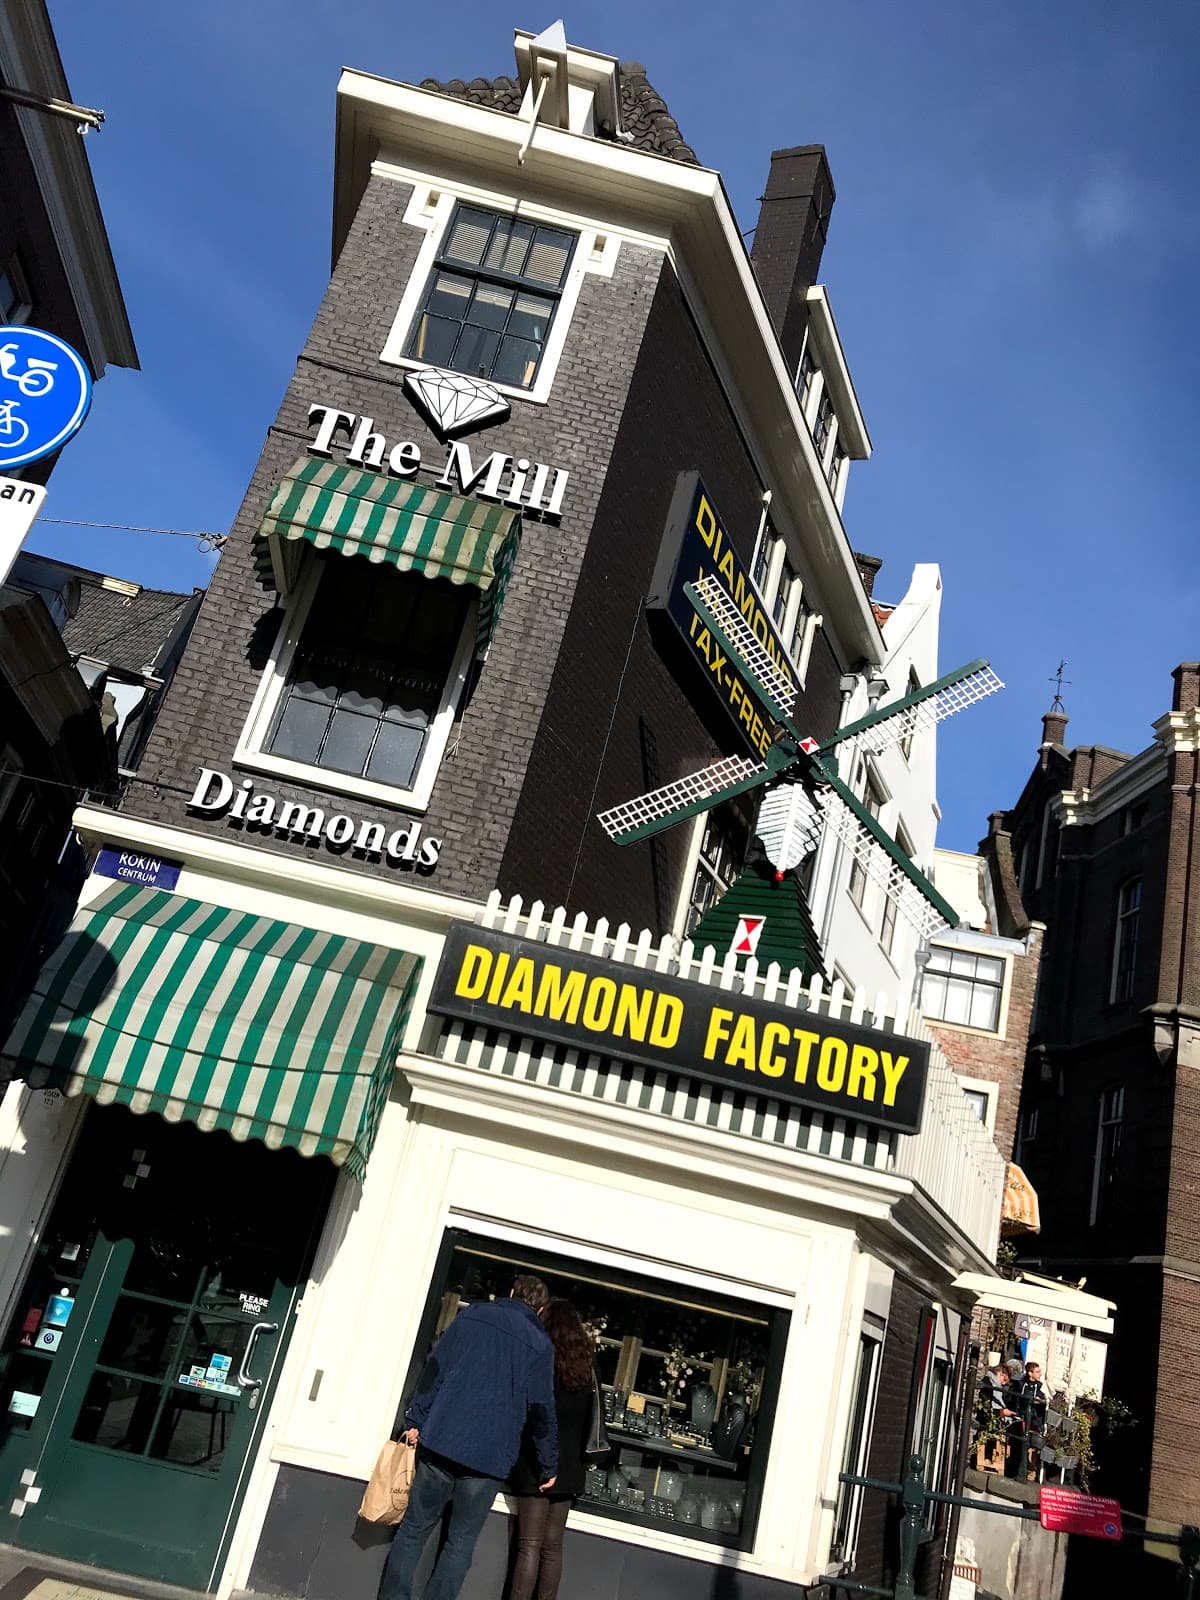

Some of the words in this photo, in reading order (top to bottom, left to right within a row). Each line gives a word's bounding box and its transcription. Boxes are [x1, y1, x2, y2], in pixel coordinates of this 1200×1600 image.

[306, 403, 421, 475] The
[435, 439, 570, 516] Mill
[689, 612, 772, 759] TAX-FREE
[184, 766, 443, 867] Diamonds
[117, 867, 157, 883] CENTRUM
[118, 851, 162, 873] ROKIN
[454, 943, 685, 1049] DIAMOND
[703, 1006, 910, 1107] FACTORY
[239, 1293, 270, 1307] PLEASE
[242, 1302, 261, 1313] RING
